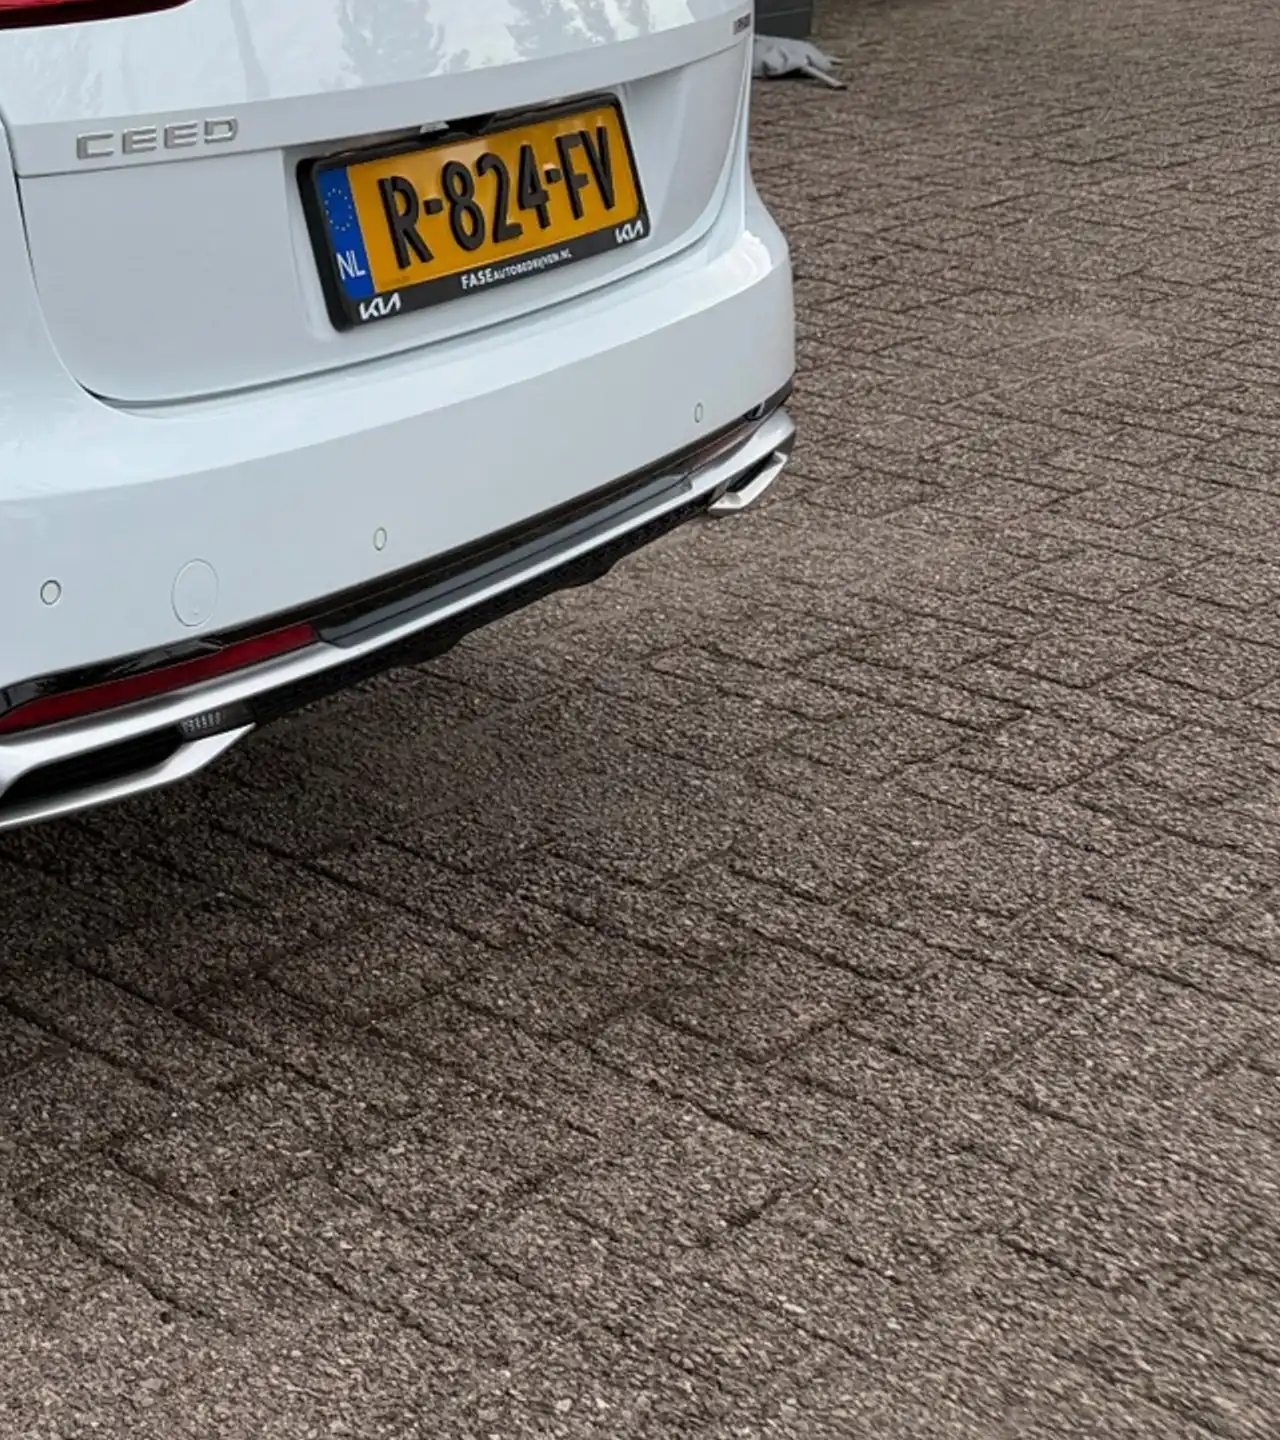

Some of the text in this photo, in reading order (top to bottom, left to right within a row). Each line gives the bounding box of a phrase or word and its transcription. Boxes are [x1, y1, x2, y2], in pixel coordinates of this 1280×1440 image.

[76, 116, 239, 160] CEED
[336, 126, 616, 281] NL R-824-FV
